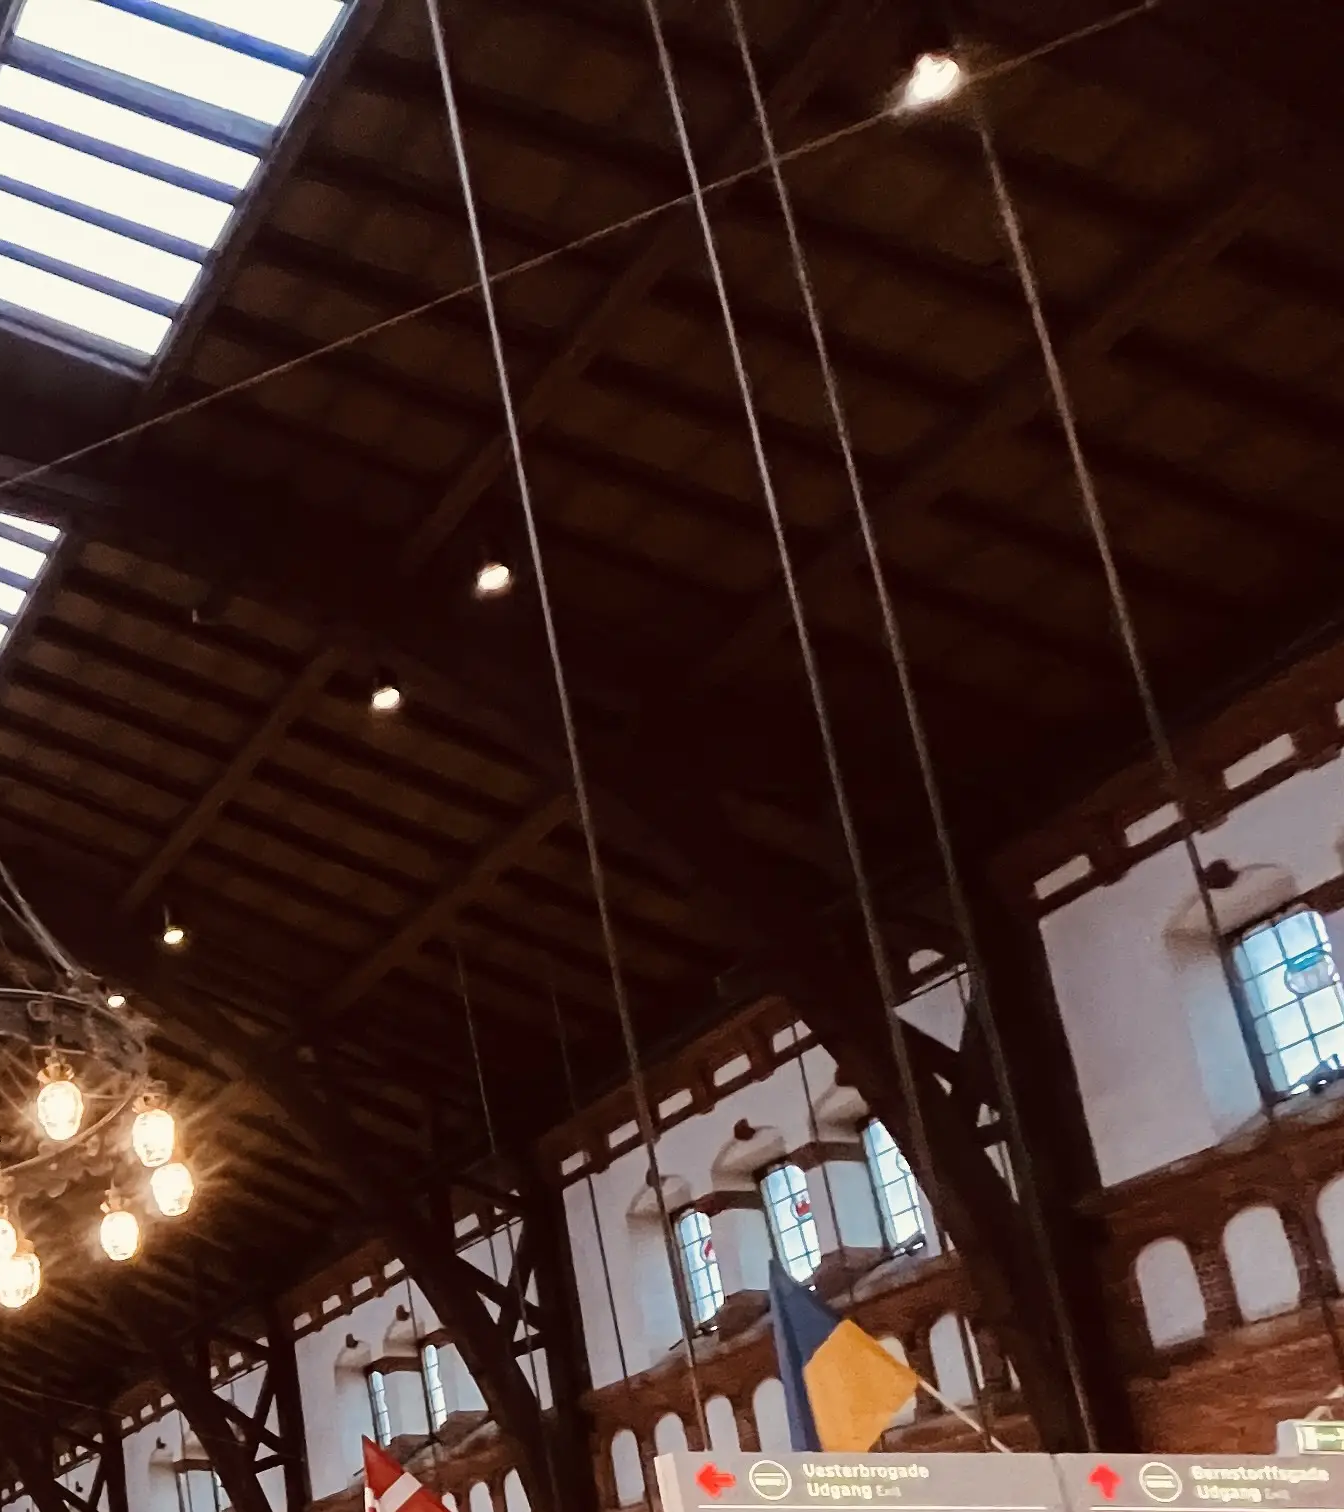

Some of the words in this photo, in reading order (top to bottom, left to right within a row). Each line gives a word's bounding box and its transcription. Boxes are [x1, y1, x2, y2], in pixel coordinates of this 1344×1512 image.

[802, 1463, 930, 1481] Vesterbrogade
[806, 1482, 873, 1500] Udgang
[1196, 1484, 1262, 1503] Udgang
